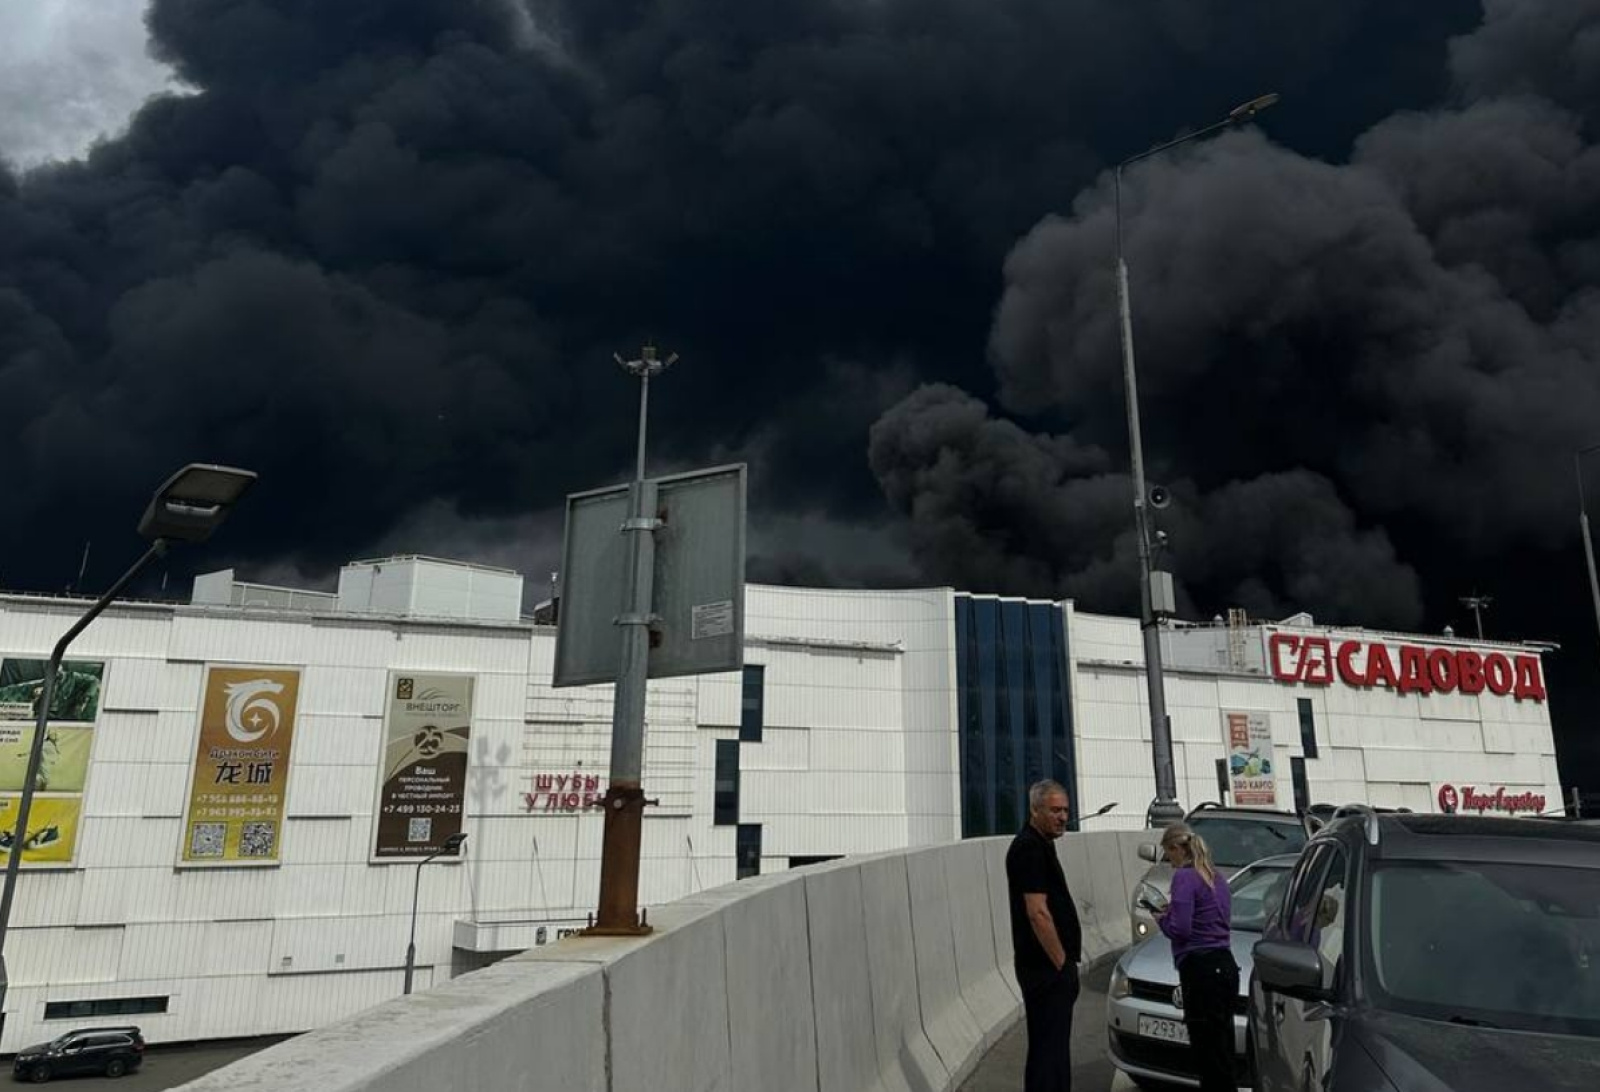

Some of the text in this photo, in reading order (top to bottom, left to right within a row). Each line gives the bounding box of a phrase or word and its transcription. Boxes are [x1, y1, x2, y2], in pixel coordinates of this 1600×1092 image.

[1337, 639, 1546, 703] САДОВОД
[405, 702, 461, 713] ВНЕШТОРГ
[215, 761, 273, 784] 龙城
[415, 764, 437, 775] Ваш
[536, 773, 600, 791] ШУБЫ
[384, 804, 395, 814] +7
[396, 804, 414, 814] 499
[525, 792, 539, 809] У
